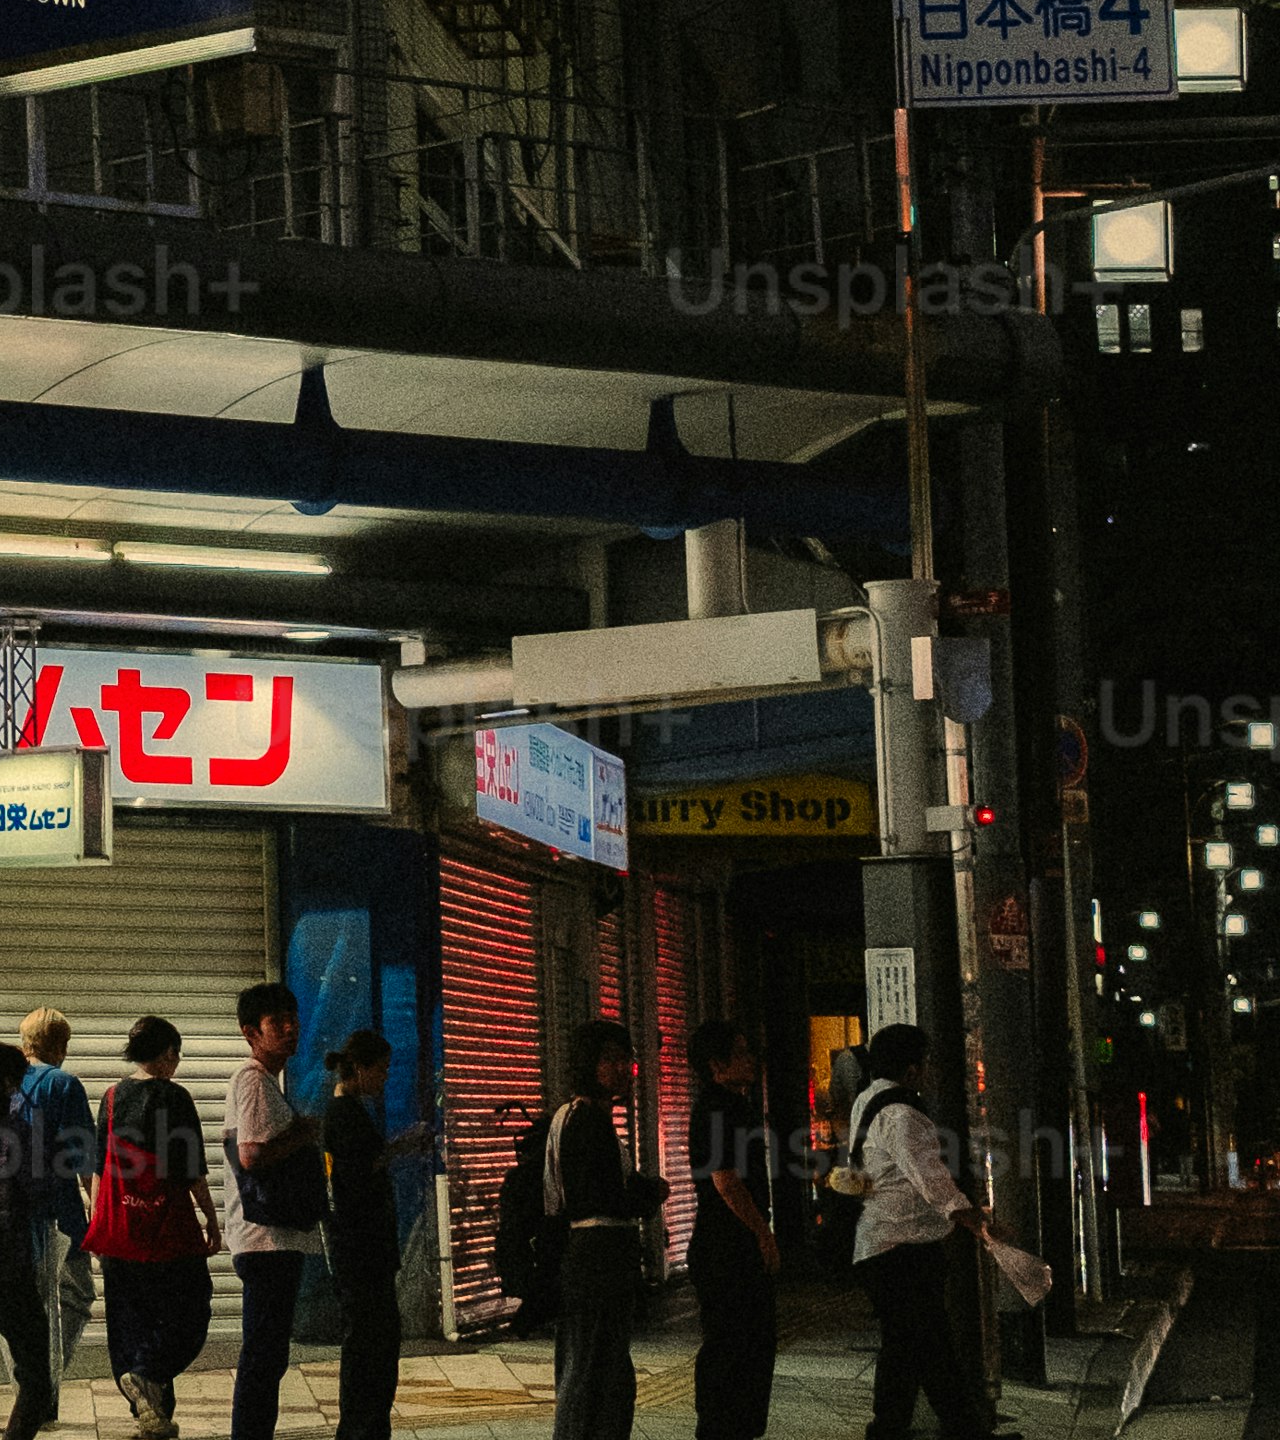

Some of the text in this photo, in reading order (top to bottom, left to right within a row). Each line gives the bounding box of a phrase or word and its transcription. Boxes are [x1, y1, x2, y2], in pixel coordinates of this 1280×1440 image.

[920, 48, 1153, 95] Nipponbashi-4
[635, 792, 724, 831] urry
[739, 788, 851, 828] Shop
